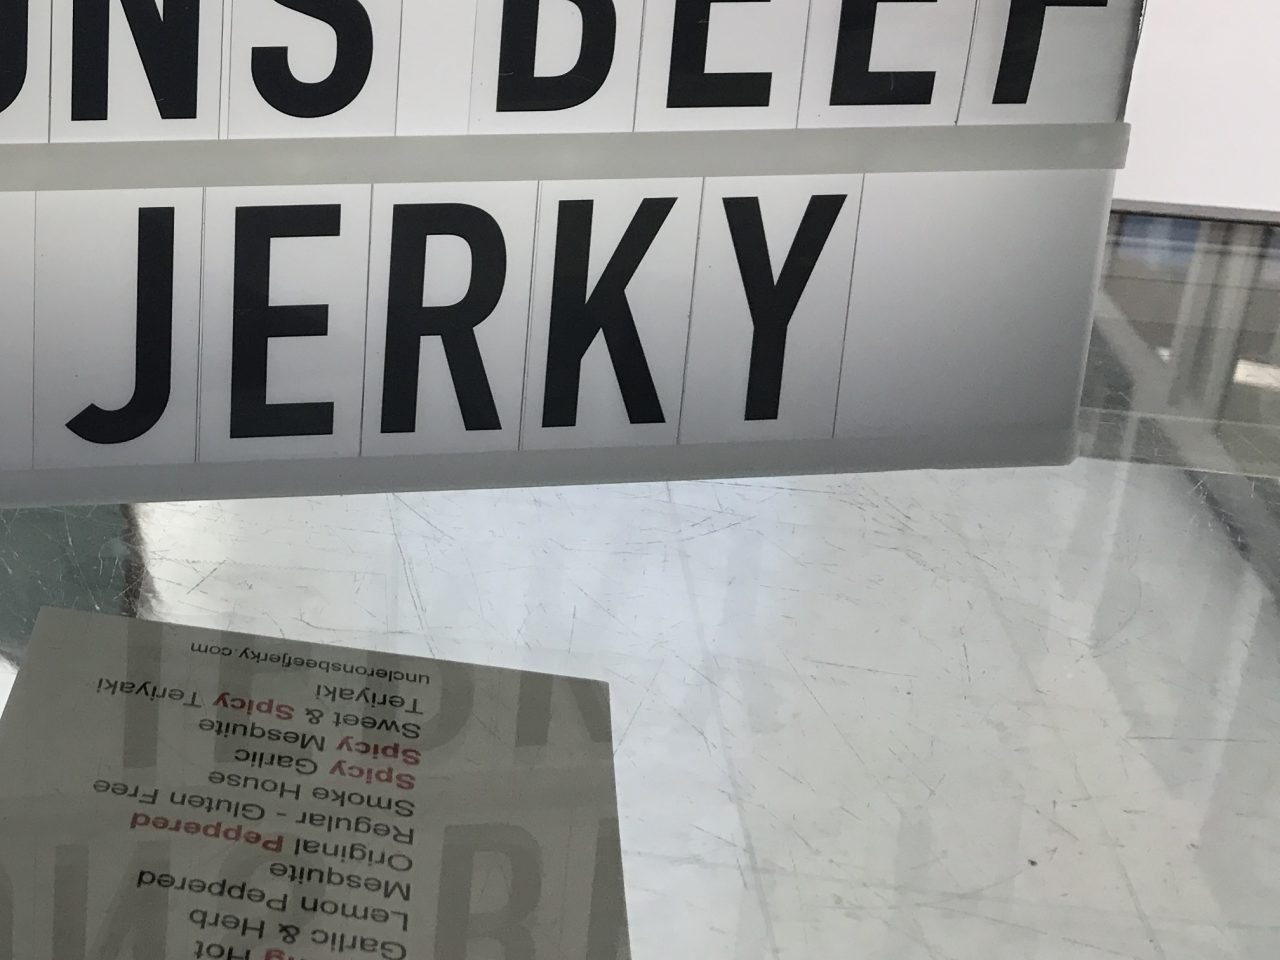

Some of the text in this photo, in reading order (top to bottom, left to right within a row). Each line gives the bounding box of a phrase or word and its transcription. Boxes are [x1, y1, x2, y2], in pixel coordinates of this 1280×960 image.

[65, 193, 848, 444] JERKY
[190, 641, 430, 685] uncleronsbeefjerky.com
[96, 677, 421, 739] Sweet & Spicy Teriyaki
[315, 683, 424, 715] Teriyaki
[198, 718, 422, 766] Spicy Mesquite
[93, 779, 159, 805] Free
[234, 748, 416, 790] Spicy Garlic
[170, 791, 266, 821] Gluten
[208, 770, 415, 818] Smoke House
[129, 811, 413, 872] Original Peppered
[295, 811, 415, 846] Regular
[136, 868, 409, 932] Lemon Peppered
[269, 861, 411, 902] Mesquite
[189, 908, 407, 960] Garlic & Herb
